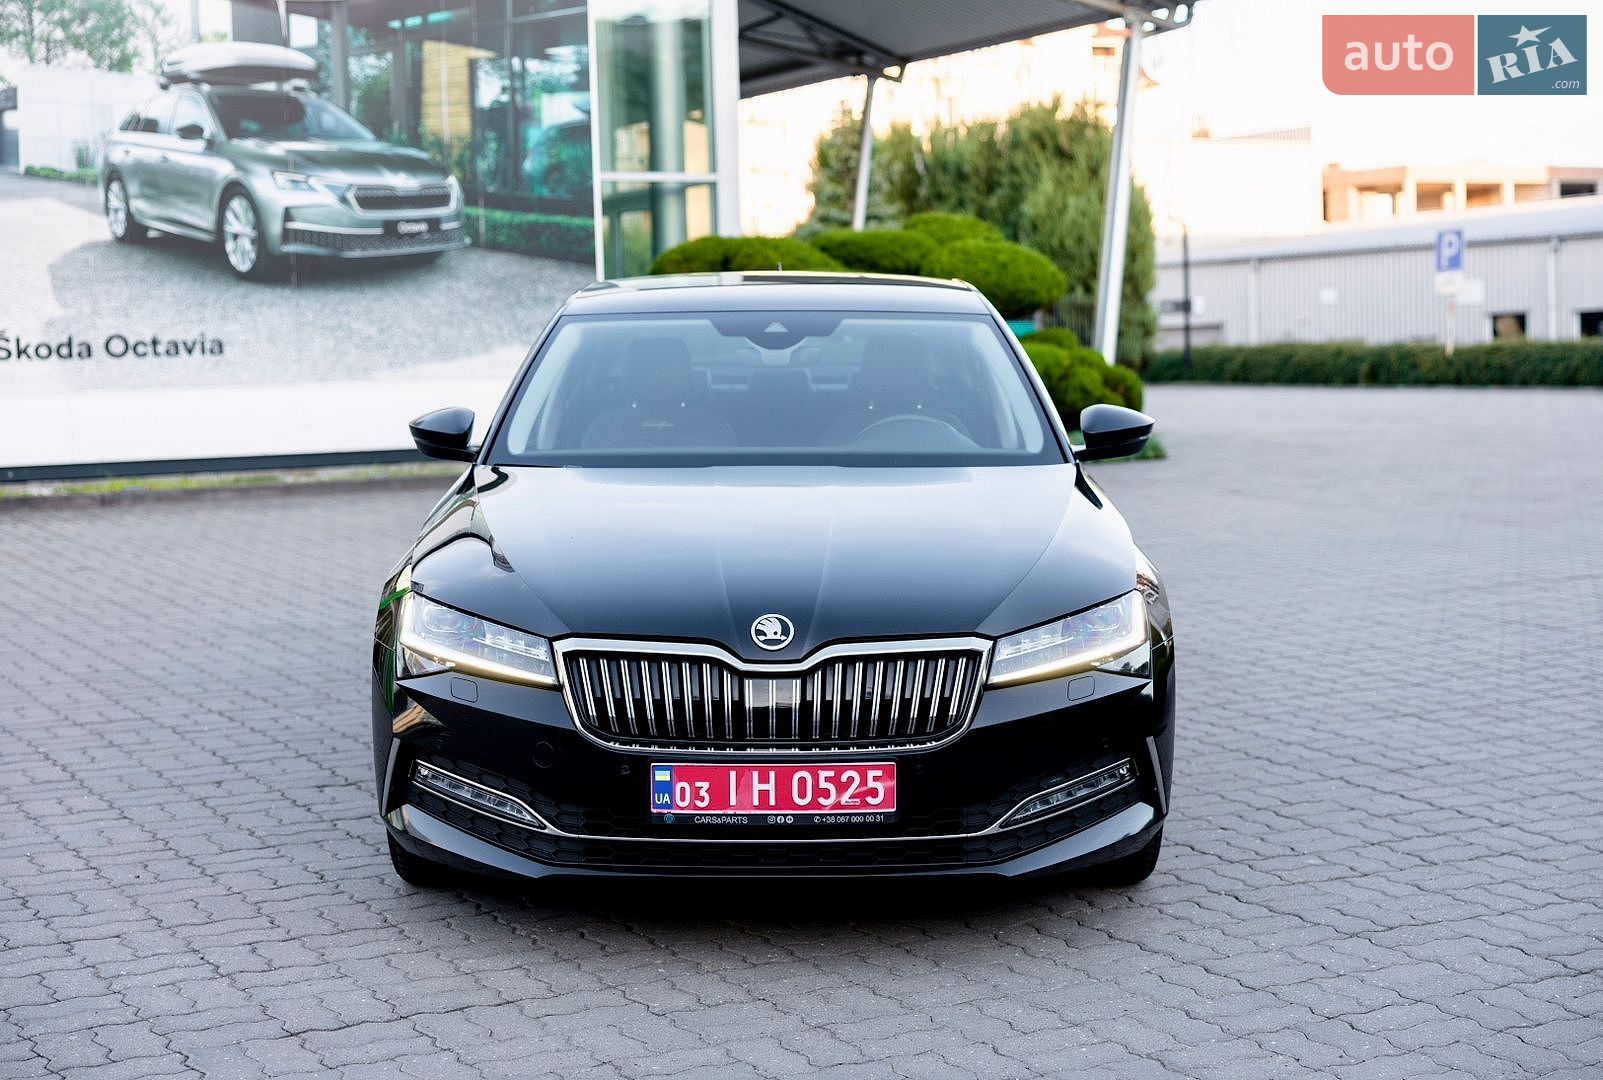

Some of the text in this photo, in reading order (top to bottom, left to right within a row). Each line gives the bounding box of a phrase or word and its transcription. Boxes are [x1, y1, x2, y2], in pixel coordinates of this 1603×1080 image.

[0, 329, 224, 361] Škoda Octavia
[675, 781, 710, 808] 03
[791, 769, 885, 806] 0525
[655, 793, 671, 804] UA
[694, 815, 749, 824] CARS&PARTS
[850, 815, 865, 823] 000
